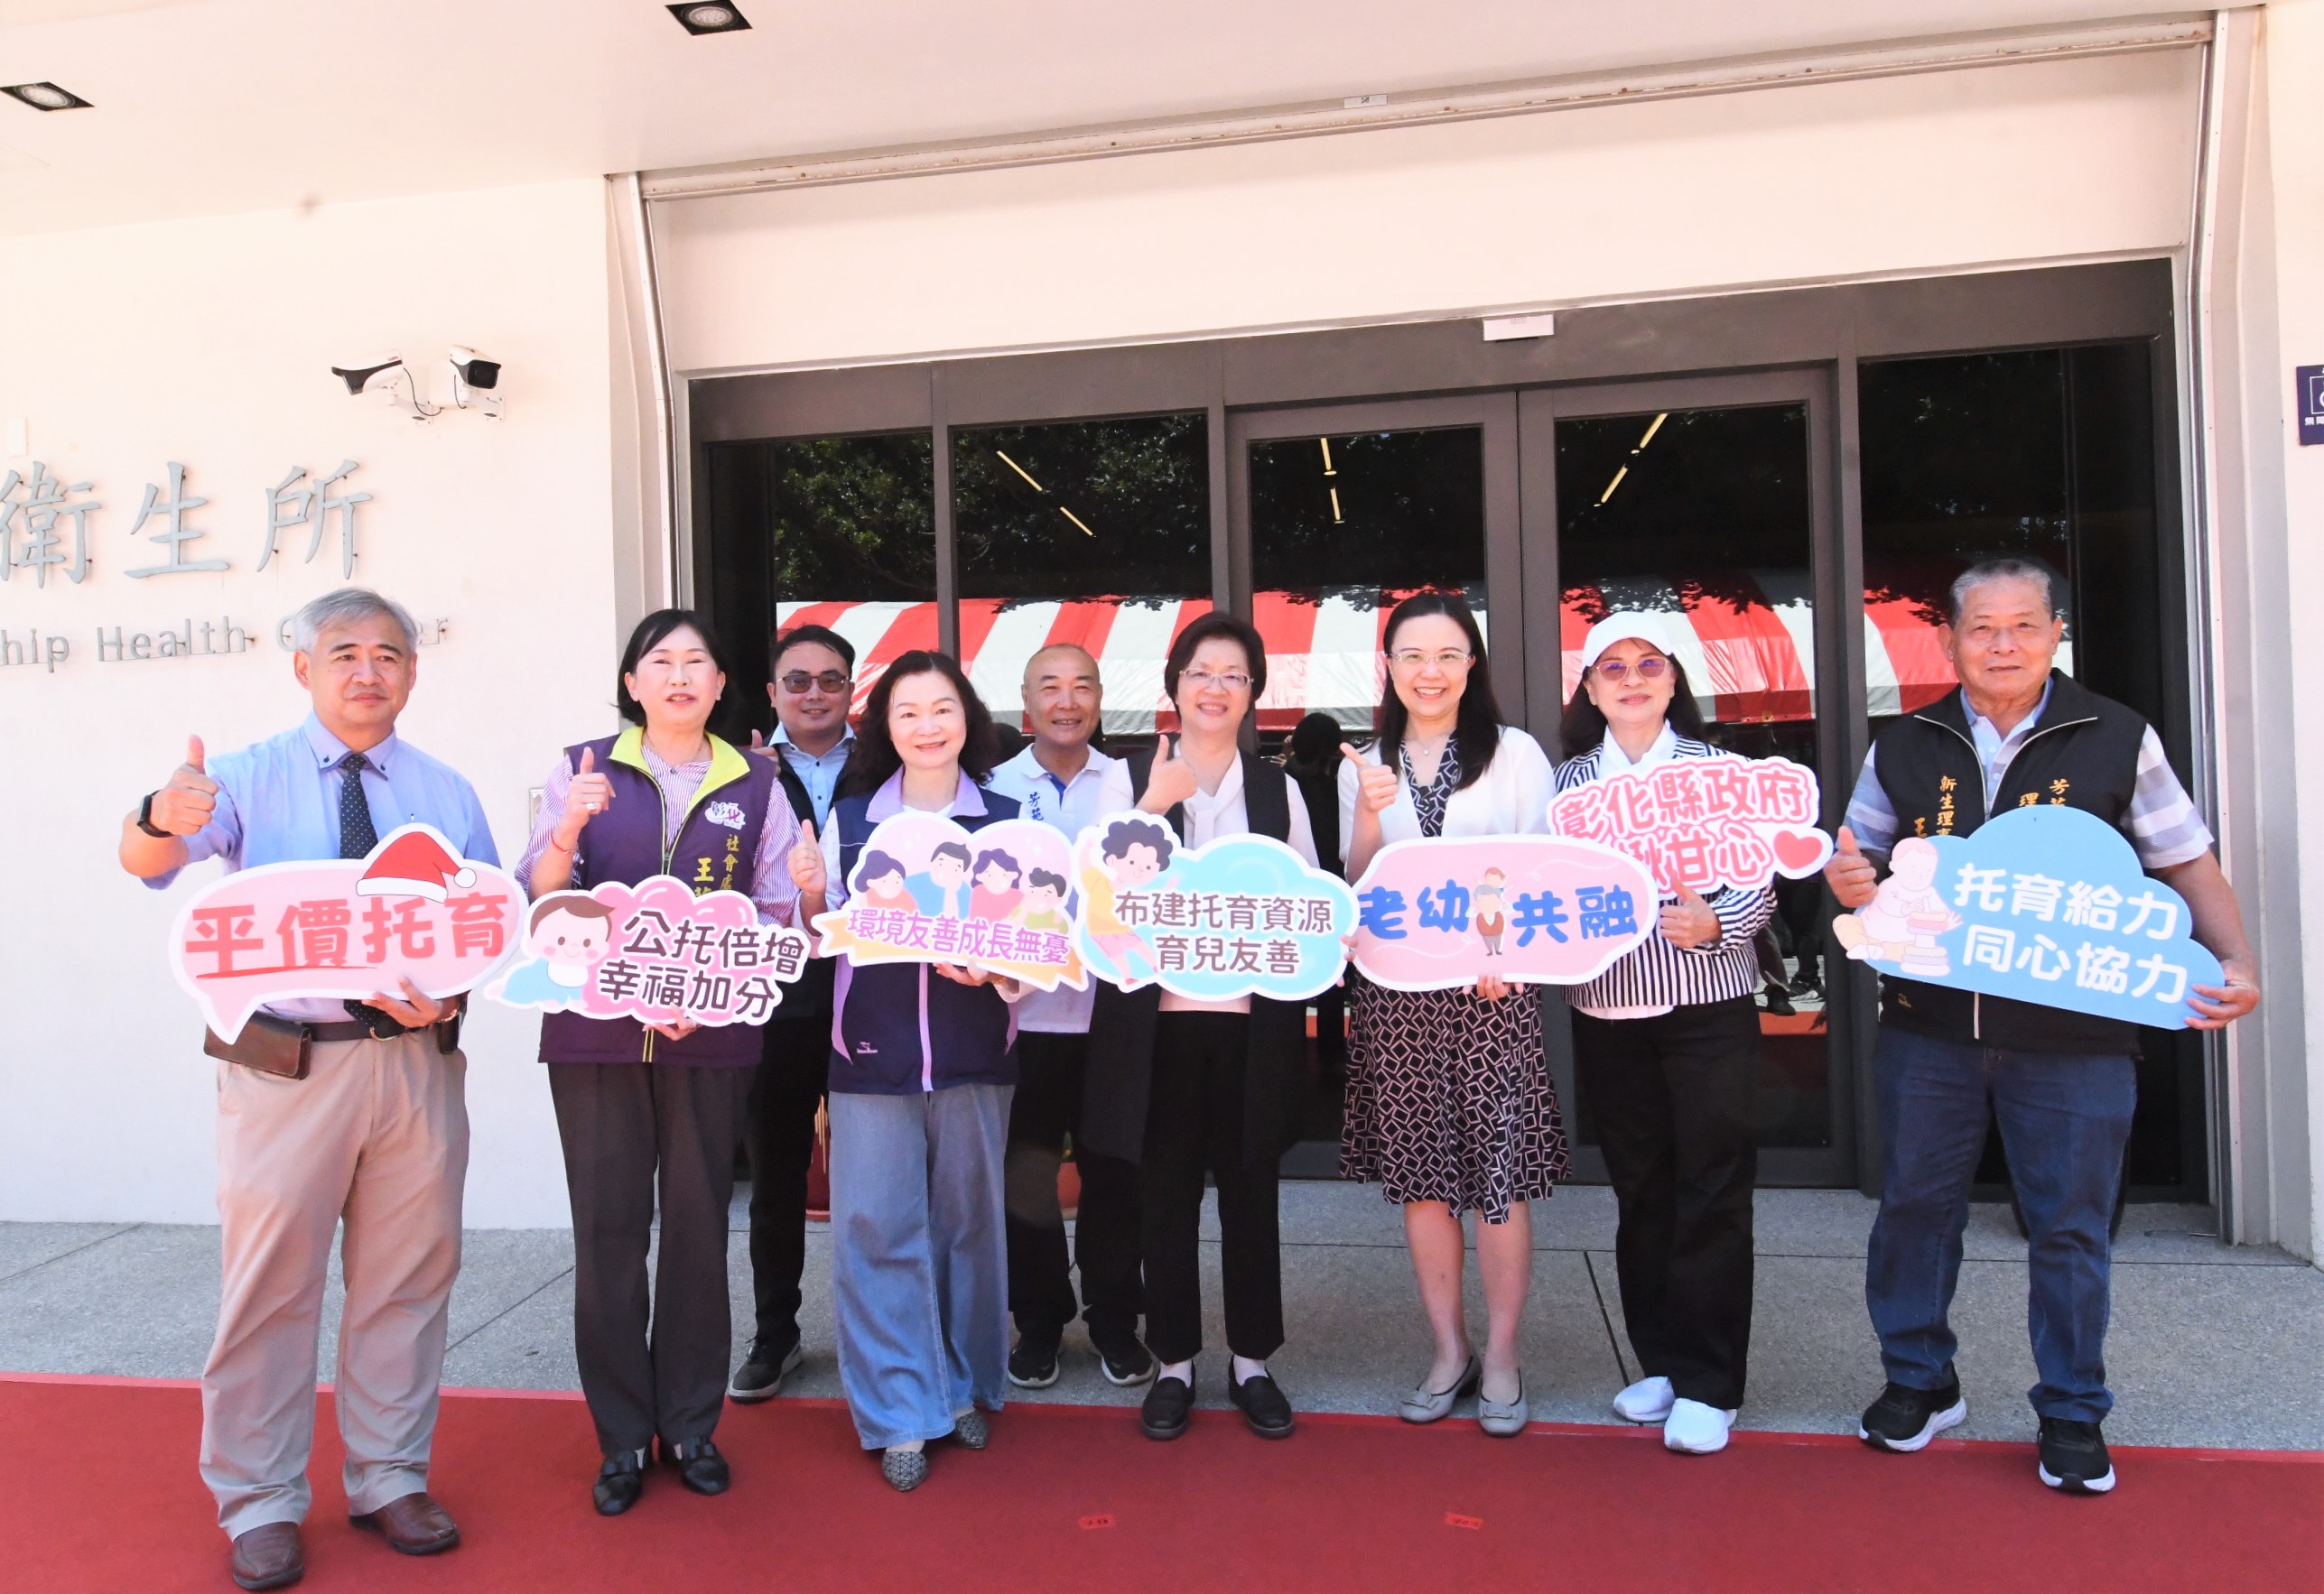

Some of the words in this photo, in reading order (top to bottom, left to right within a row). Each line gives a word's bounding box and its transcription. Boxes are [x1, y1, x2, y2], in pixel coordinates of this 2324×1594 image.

[0, 459, 373, 588] 衛生所
[1, 628, 70, 672] hip
[97, 616, 247, 662] Health
[1559, 767, 1803, 842] 彰化縣政府
[185, 892, 508, 975] 平價托育
[1114, 891, 1334, 935] 布建托育資源
[1953, 862, 2179, 941] 托育給力
[623, 909, 804, 975] 公托倍增
[848, 908, 1072, 965] 環境友善成長無憂
[1156, 935, 1300, 976] 育兒友善
[1963, 924, 2189, 1005] 同心協力
[599, 959, 776, 1017] 幸福加分
